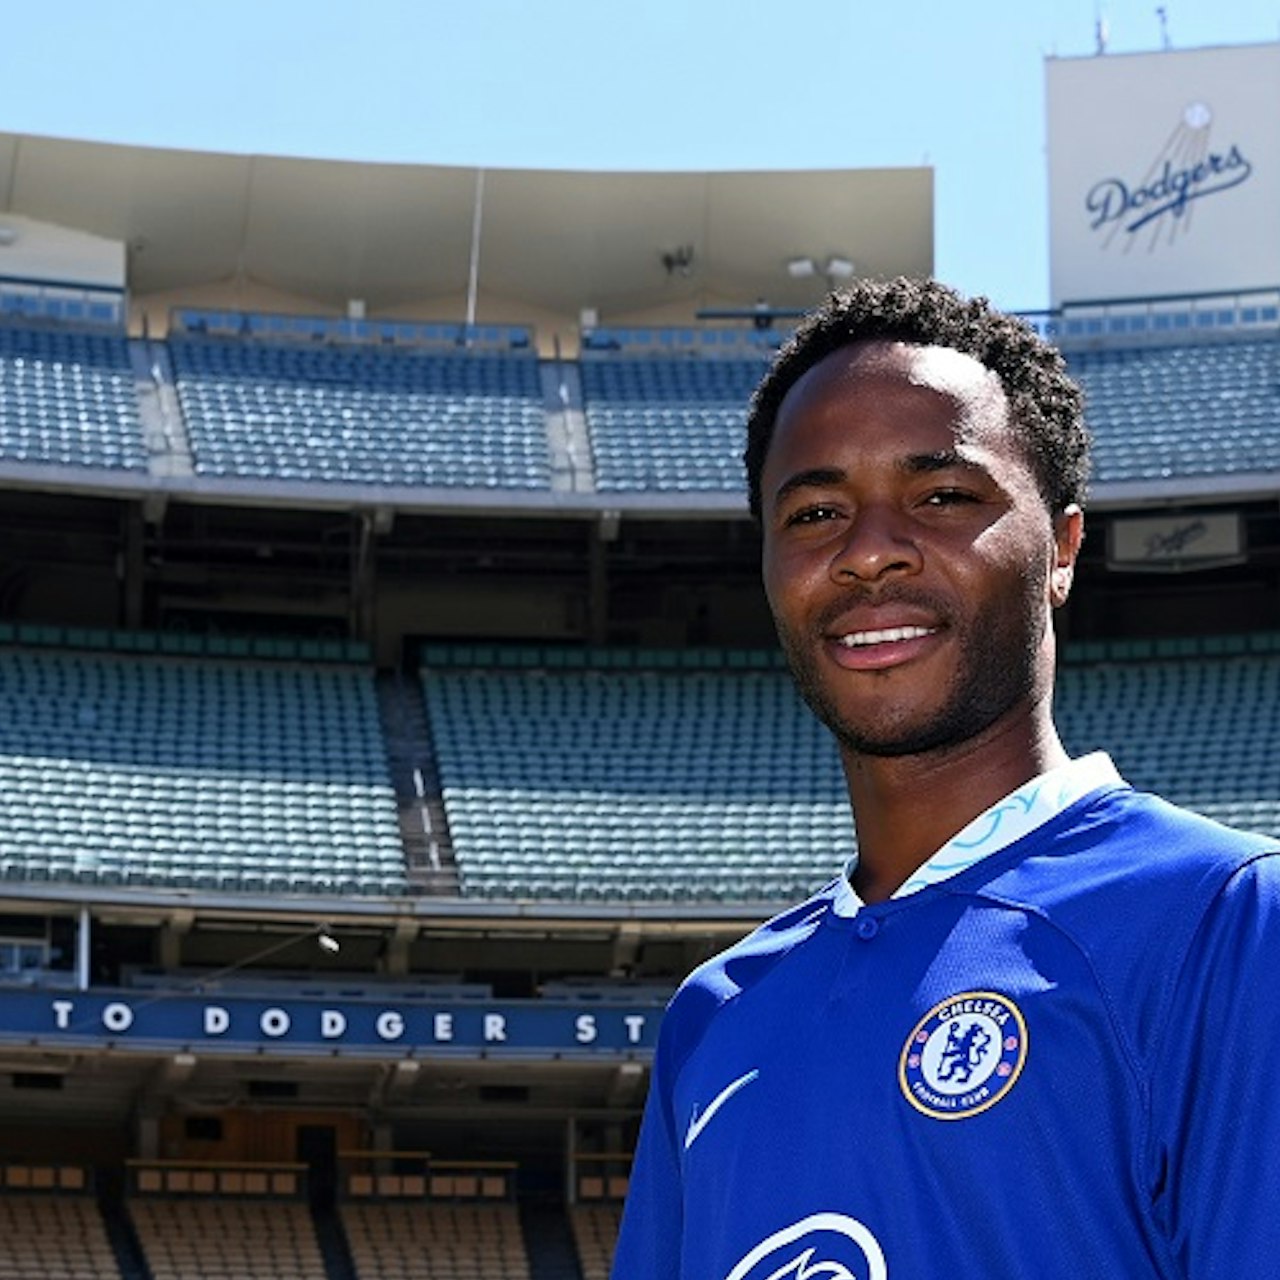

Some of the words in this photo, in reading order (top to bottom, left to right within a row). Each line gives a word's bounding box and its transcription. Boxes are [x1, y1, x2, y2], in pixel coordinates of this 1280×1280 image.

[1086, 145, 1252, 232] Dodgers
[53, 1001, 132, 1031] TO
[205, 1007, 507, 1041] DODGER
[938, 999, 1010, 1026] CHELSEA
